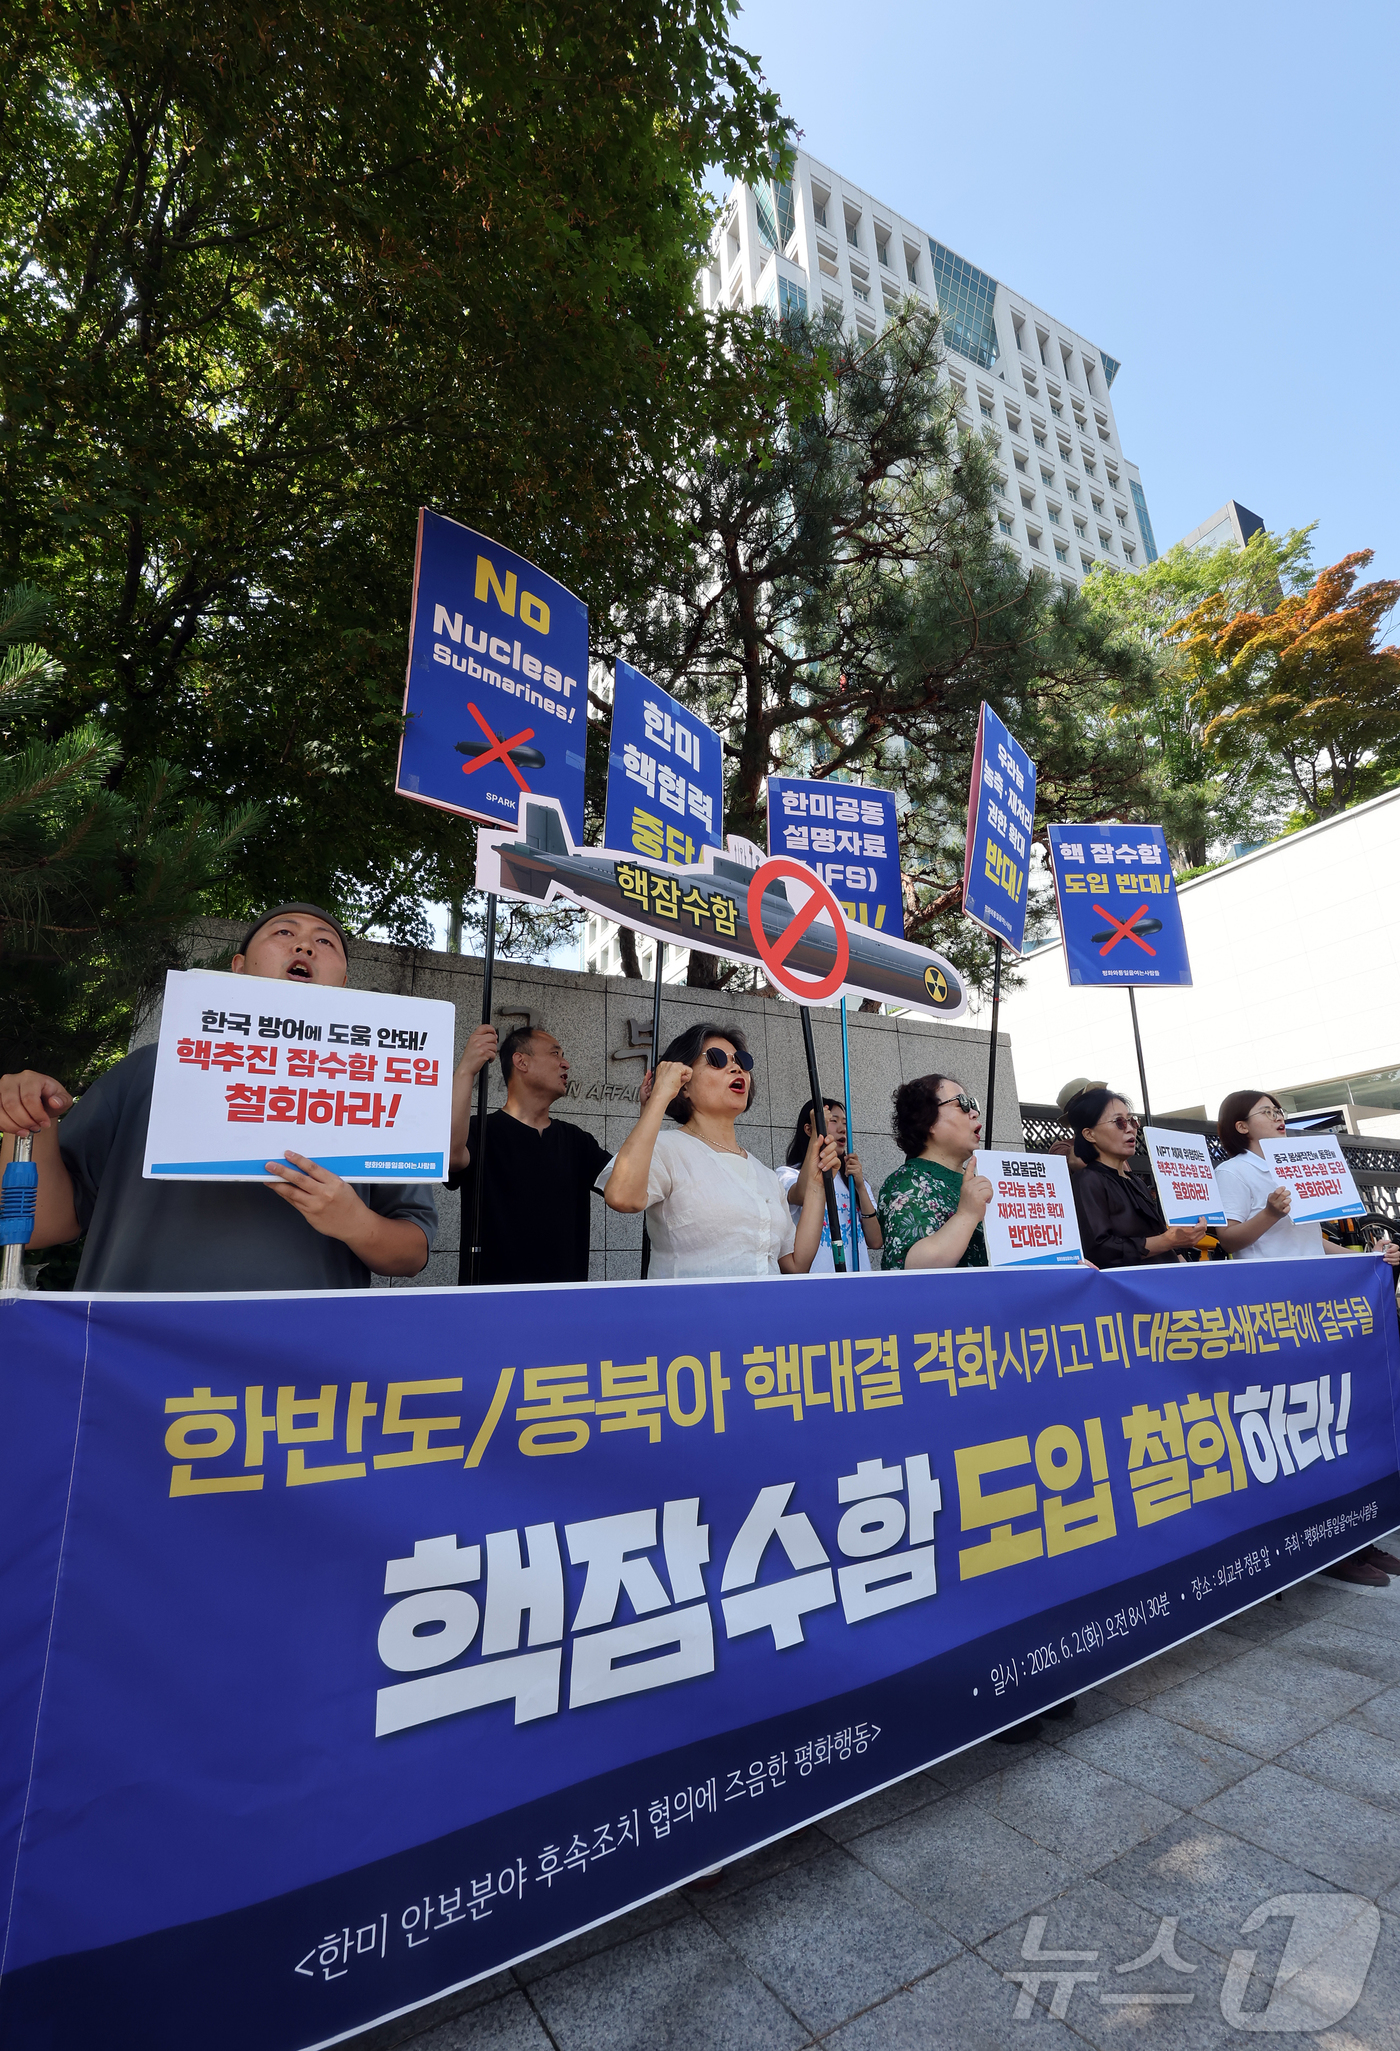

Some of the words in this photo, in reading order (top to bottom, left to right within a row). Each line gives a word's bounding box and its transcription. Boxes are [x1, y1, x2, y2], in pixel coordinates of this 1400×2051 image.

[474, 554, 551, 635] No
[433, 602, 577, 698] Nuclear
[433, 642, 576, 724] Submarines!
[643, 699, 700, 773] 한미
[623, 742, 713, 834] 핵협력
[998, 743, 1024, 792] 우라늄
[485, 792, 516, 810] SPARK
[781, 790, 885, 826] 한미공동
[782, 824, 888, 859] 설명자료
[987, 798, 1007, 838] 권한
[1008, 822, 1026, 859] 확대
[984, 837, 1024, 904] 반대!
[1059, 842, 1085, 864] 핵
[1090, 843, 1162, 864] 잠수함
[615, 862, 738, 938] 핵잠수함
[1064, 873, 1110, 894] 도입
[1115, 873, 1171, 894] 반대!
[201, 1009, 251, 1036] 한국
[258, 1015, 322, 1041] 방어에
[327, 1022, 372, 1047] 도움
[376, 1027, 428, 1051] 안돼!
[176, 1037, 278, 1075] 핵추진
[286, 1048, 378, 1082] 잠수함
[384, 1056, 439, 1086] 도입
[224, 1083, 402, 1129] 철회하라!
[585, 1081, 641, 1102] AFFAI
[1001, 1160, 1046, 1178] 불요불급한
[1156, 1145, 1171, 1158] NPT
[1156, 1160, 1179, 1177] 핵추진
[1178, 1163, 1199, 1179] 잠수함
[1198, 1164, 1213, 1179] 도입
[1273, 1152, 1289, 1164] 중국
[1274, 1165, 1303, 1180] 핵추진
[1302, 1162, 1329, 1177] 잠수함
[1328, 1161, 1346, 1174] 도입
[997, 1202, 1027, 1219] 재처리
[1027, 1203, 1046, 1219] 권한
[1046, 1202, 1065, 1218] 확대
[998, 1181, 1026, 1198] 우라늄
[1027, 1181, 1046, 1198] 농축
[1046, 1182, 1057, 1198] 및
[1172, 1181, 1210, 1201] 철회하라!
[1294, 1178, 1343, 1199] 철회하라!
[1008, 1224, 1063, 1248] 반대한다!
[164, 1351, 731, 1498] 한반도/동북아
[743, 1335, 904, 1421] 핵대결
[912, 1323, 1094, 1397] 격화시키고
[1095, 1312, 1131, 1369] 미
[1132, 1300, 1321, 1364] 대중봉쇄전략에
[1315, 1296, 1374, 1342] 결부될
[1284, 1531, 1301, 1556] 주최
[1303, 1500, 1379, 1547] 평화와통일을여는사람들
[375, 1452, 943, 1738] 핵잠수함
[953, 1417, 1118, 1581] 도입
[1122, 1371, 1352, 1529] 철회하라!
[1191, 1576, 1213, 1601] 장소
[1217, 1558, 1244, 1587] 외교부
[1243, 1549, 1262, 1576] 정문
[1260, 1546, 1272, 1568] 앞
[990, 1658, 1019, 1696] 일시
[1027, 1642, 1061, 1676] 2026.
[1105, 1608, 1130, 1640] 오전
[1128, 1600, 1148, 1628] 8시
[1146, 1591, 1171, 1619] 30분
[294, 1913, 388, 1981] <한미
[401, 1858, 528, 1948] 안보분야
[535, 1808, 640, 1888] 후속조치
[647, 1777, 718, 1840] 협의에
[724, 1751, 789, 1801] 즈음한
[794, 1721, 882, 1777] 평화행동>
